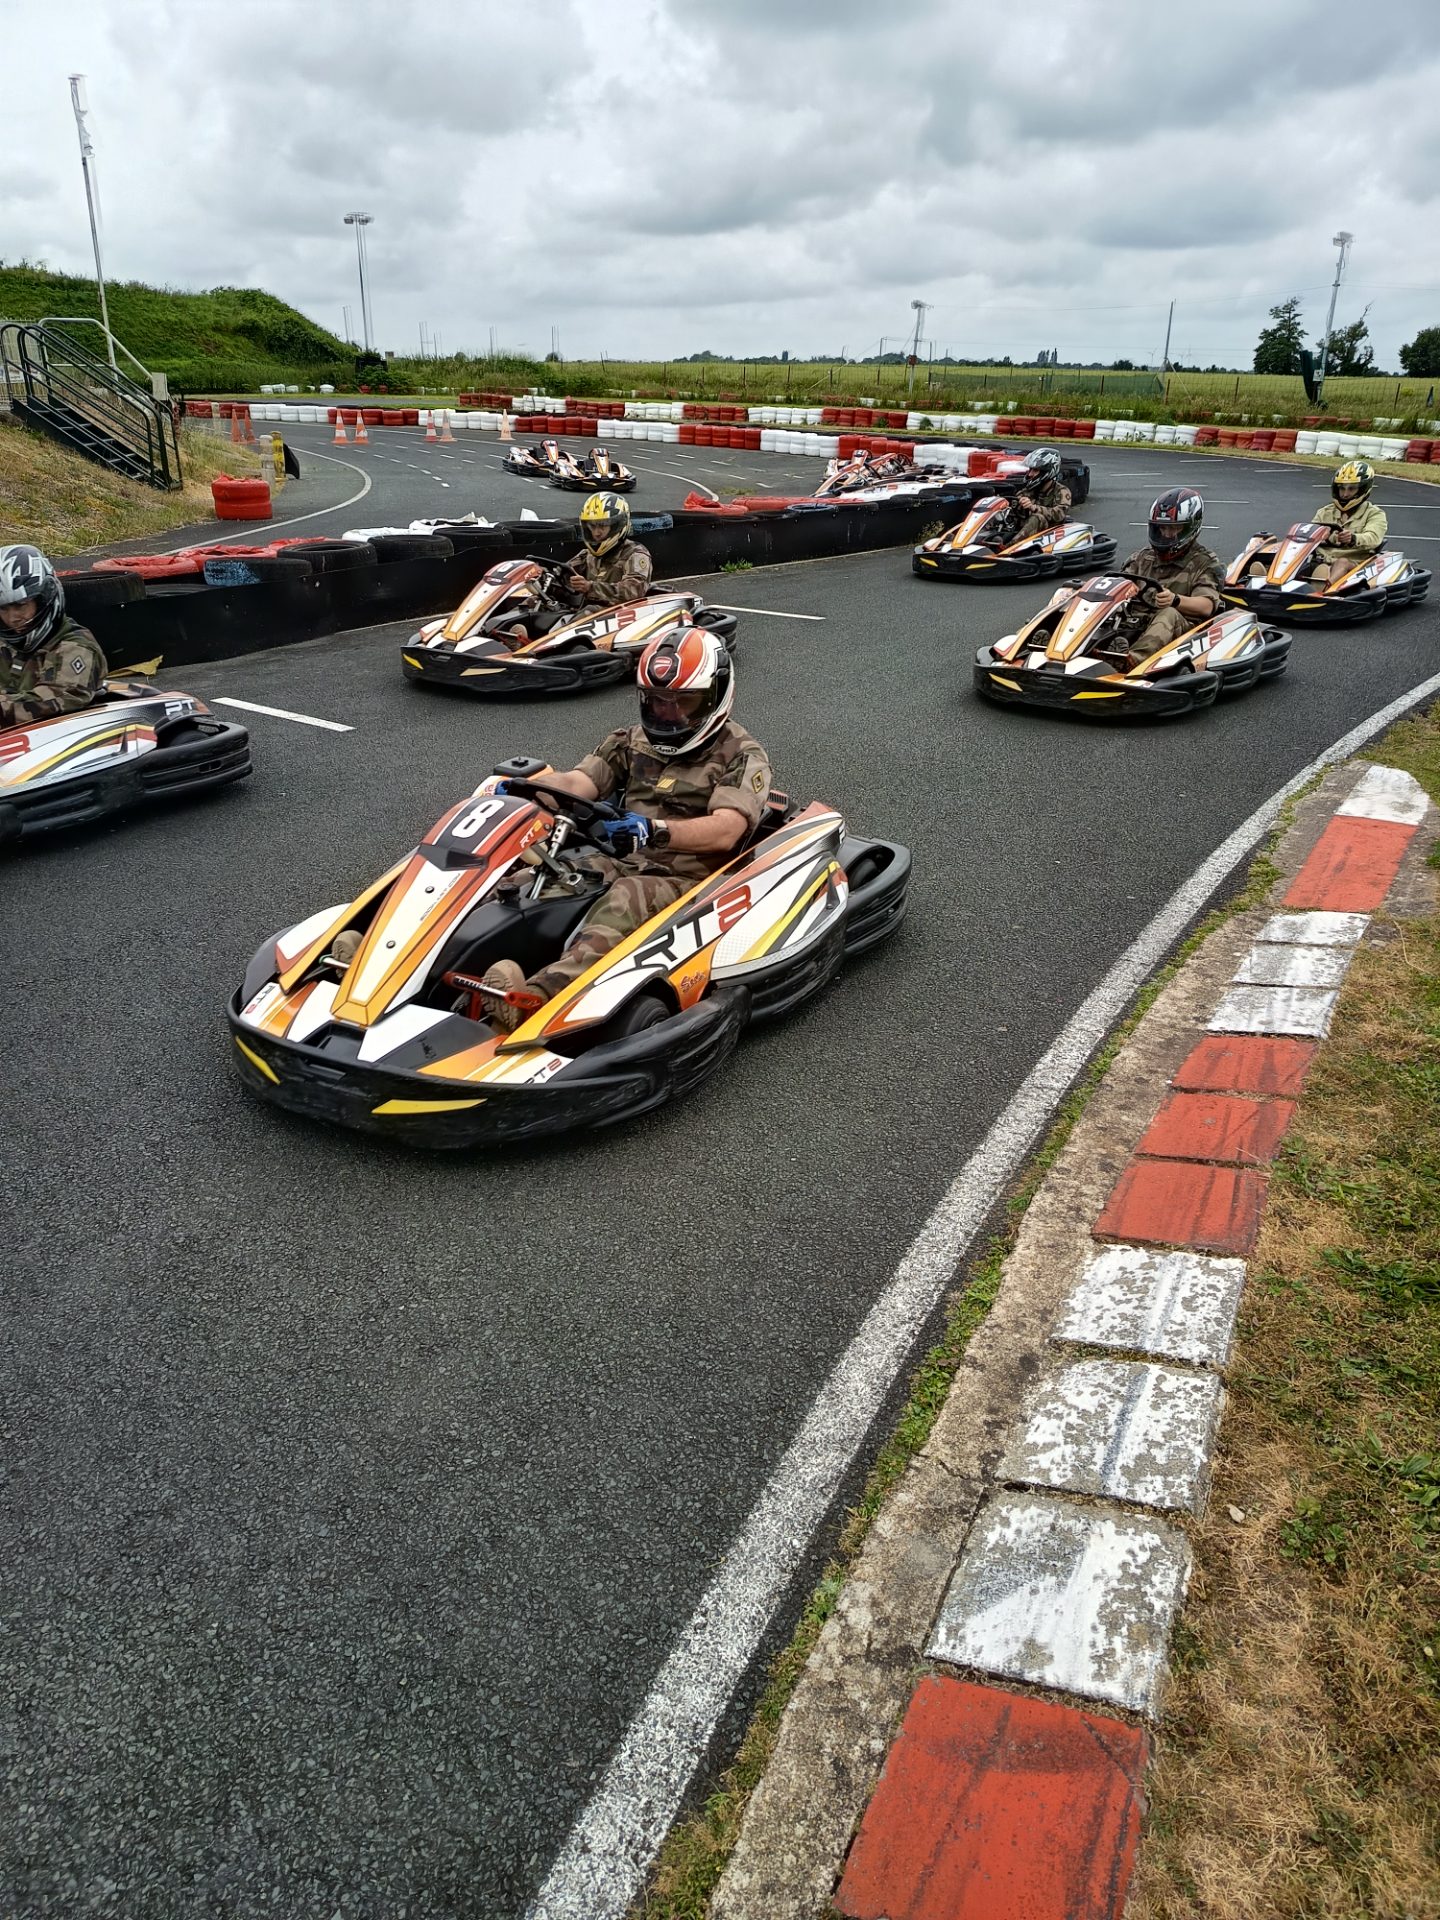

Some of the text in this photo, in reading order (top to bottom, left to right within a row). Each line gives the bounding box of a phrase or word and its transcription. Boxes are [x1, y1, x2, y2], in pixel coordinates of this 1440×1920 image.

[452, 799, 505, 838] 8
[520, 819, 543, 848] RT8
[633, 884, 752, 967] RT8
